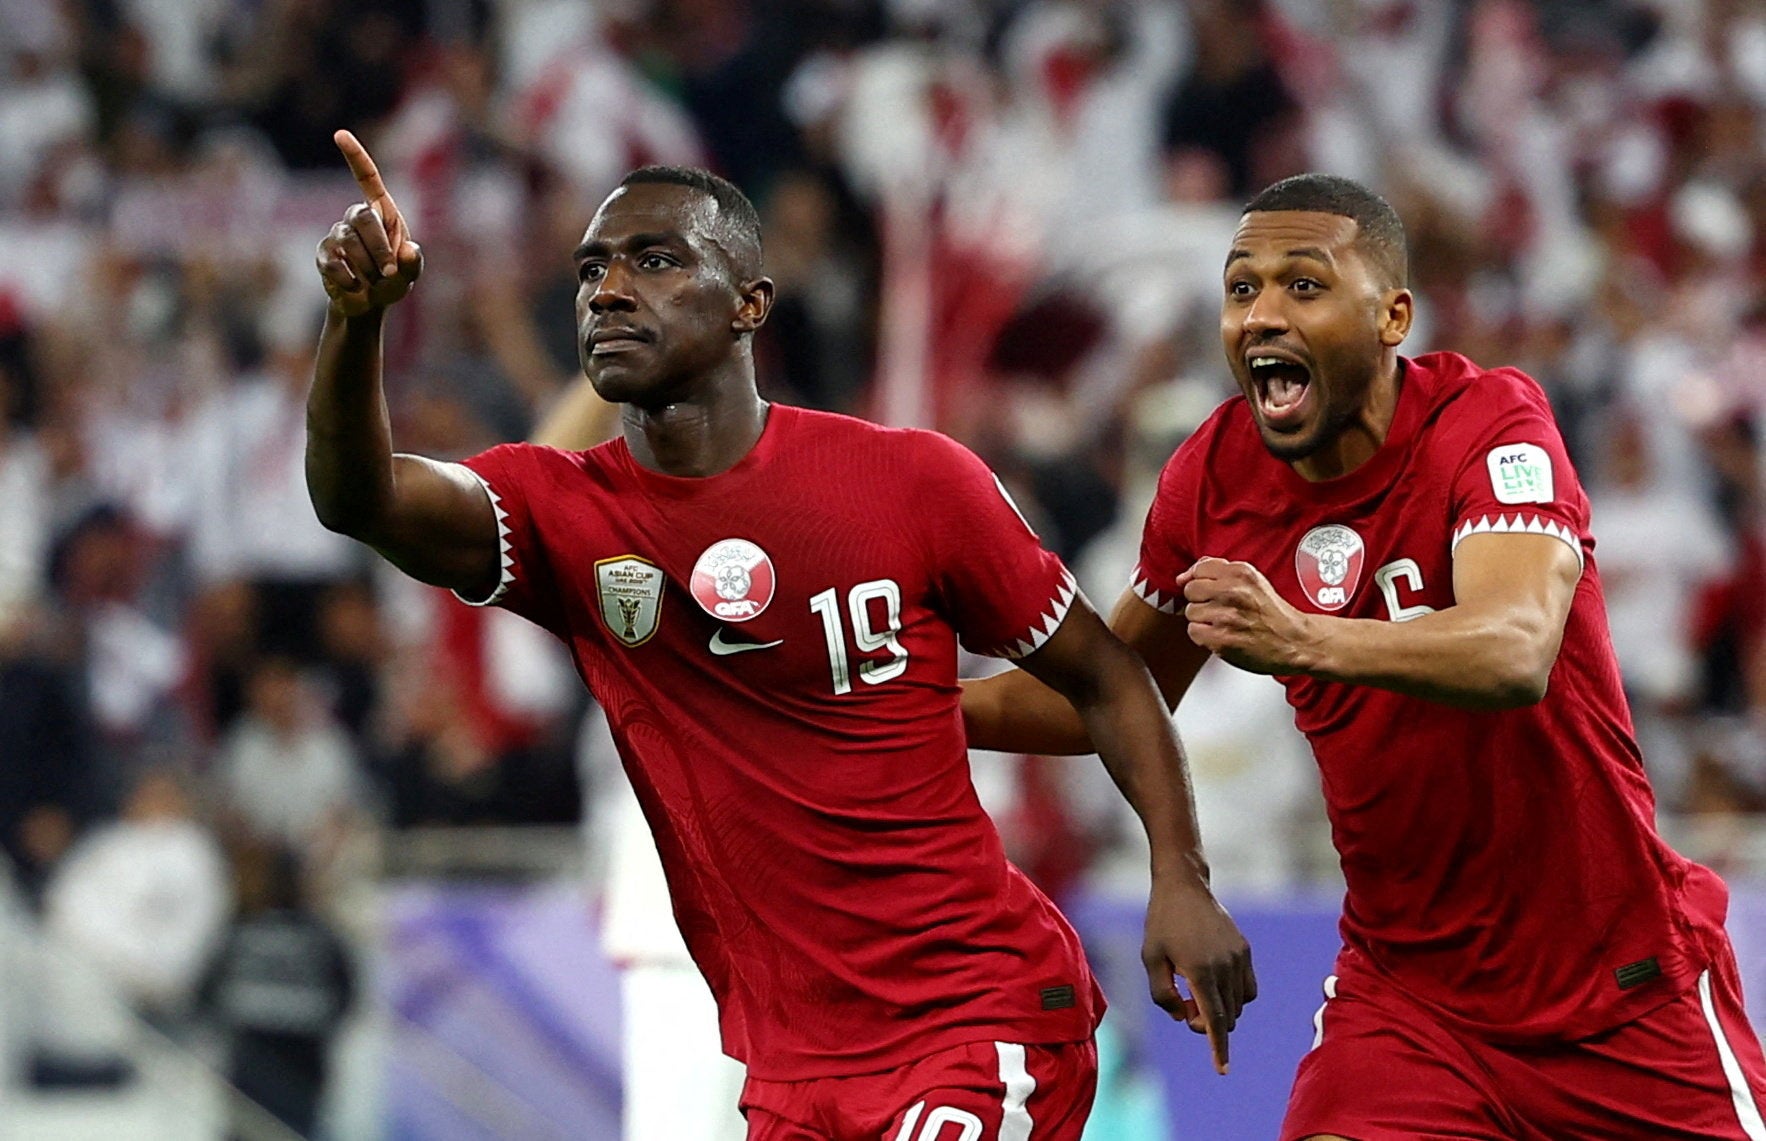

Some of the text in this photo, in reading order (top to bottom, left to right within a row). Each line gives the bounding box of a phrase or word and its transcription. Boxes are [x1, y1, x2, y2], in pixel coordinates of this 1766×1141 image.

[1499, 453, 1527, 465] AFC
[608, 570, 634, 578] ASIAN
[608, 586, 652, 595] CHAMPIONS
[714, 600, 759, 616] QFA
[809, 579, 909, 695] 19
